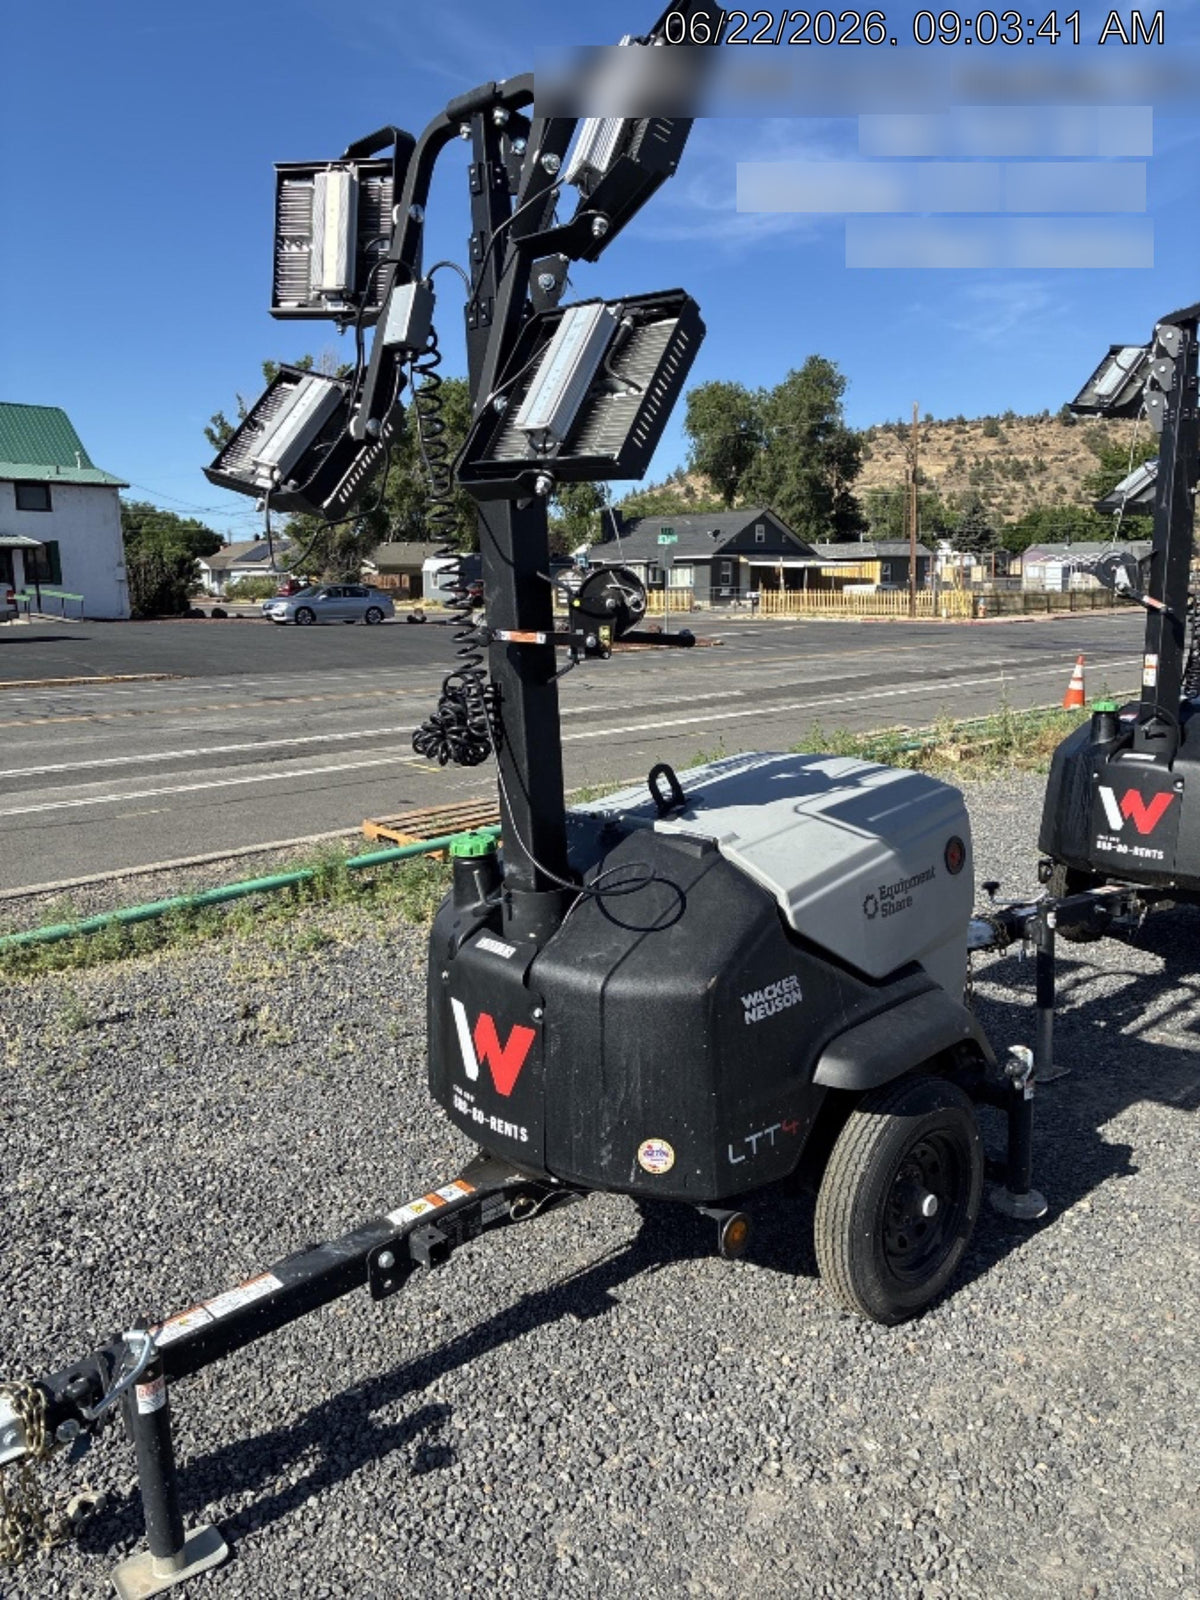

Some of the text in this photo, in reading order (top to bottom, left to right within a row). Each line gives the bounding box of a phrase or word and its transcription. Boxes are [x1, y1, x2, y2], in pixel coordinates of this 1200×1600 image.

[878, 865, 937, 901] Equipment
[881, 895, 914, 918] Share
[740, 974, 800, 1009] WACKER
[744, 988, 803, 1025] NEUSON
